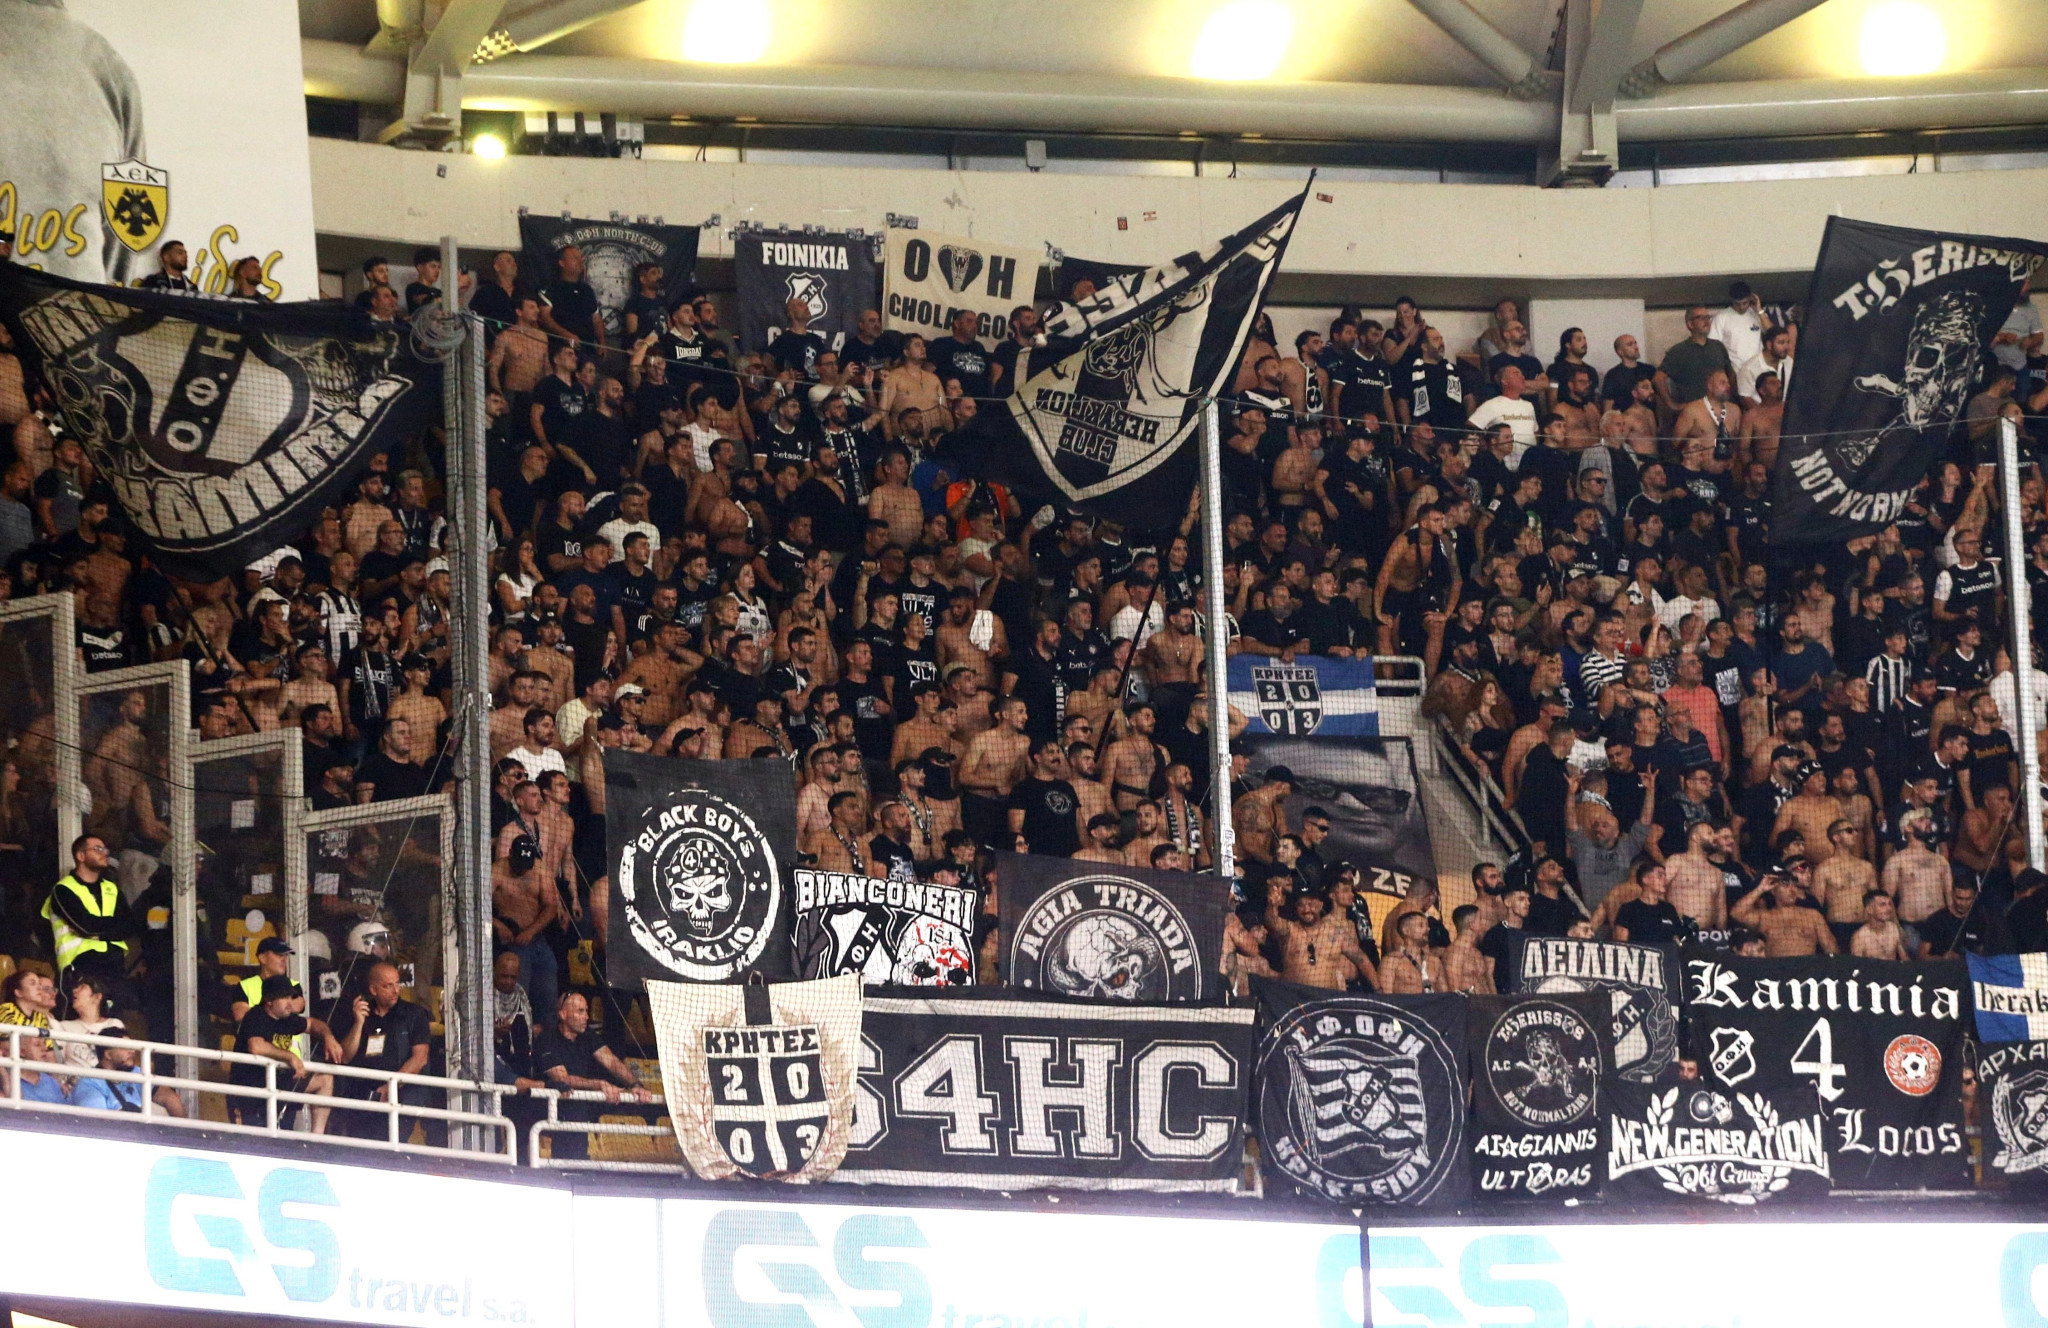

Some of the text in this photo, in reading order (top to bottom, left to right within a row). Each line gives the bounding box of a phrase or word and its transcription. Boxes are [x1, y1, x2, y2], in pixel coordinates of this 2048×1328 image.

[604, 228, 639, 243] NORTH
[761, 241, 849, 271] FOINIKIA
[638, 805, 755, 858] BLACK BOYS
[796, 871, 976, 934] BIANCONERI
[652, 920, 755, 961] IRAKLIO
[1020, 884, 1194, 975] AGIA TRIADA
[1688, 959, 1960, 1021] Kaminia
[704, 1028, 819, 1054] ΚΡΗΤΕΣ
[1790, 1017, 1847, 1102] 4
[721, 1062, 810, 1101] 2 0
[730, 1124, 820, 1164] 0 3
[1675, 1114, 1825, 1168] GENERATION
[1834, 1107, 1961, 1156] Locos
[144, 1155, 341, 1303] GS
[348, 1266, 473, 1318] travel
